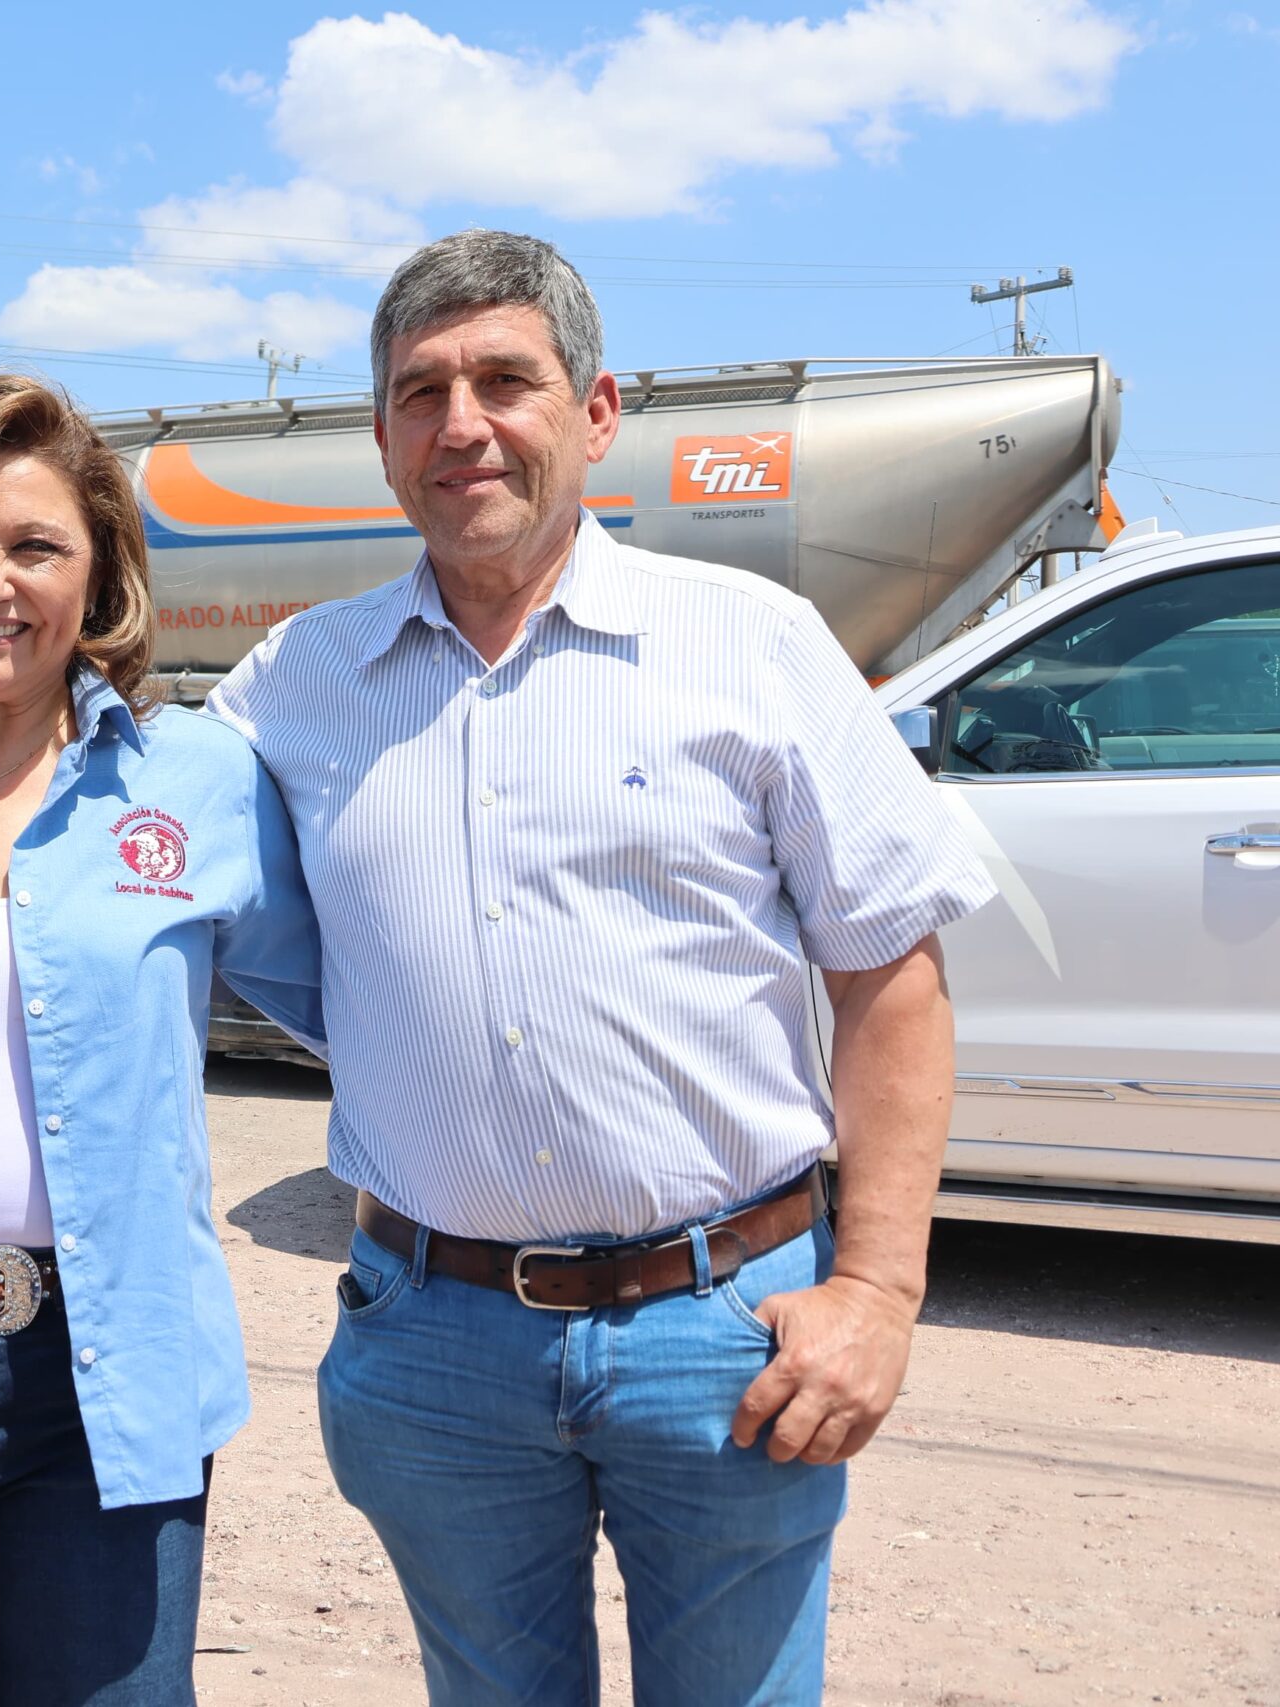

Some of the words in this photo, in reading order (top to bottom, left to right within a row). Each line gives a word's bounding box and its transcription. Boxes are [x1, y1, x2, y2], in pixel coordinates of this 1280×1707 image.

[691, 508, 766, 521] TRANSPORTES
[158, 605, 225, 631] RADO
[109, 806, 153, 837] Asociación
[154, 808, 190, 843] Ganadera
[115, 881, 142, 893] Local
[143, 884, 156, 895] de
[158, 885, 194, 901] Sabinas
